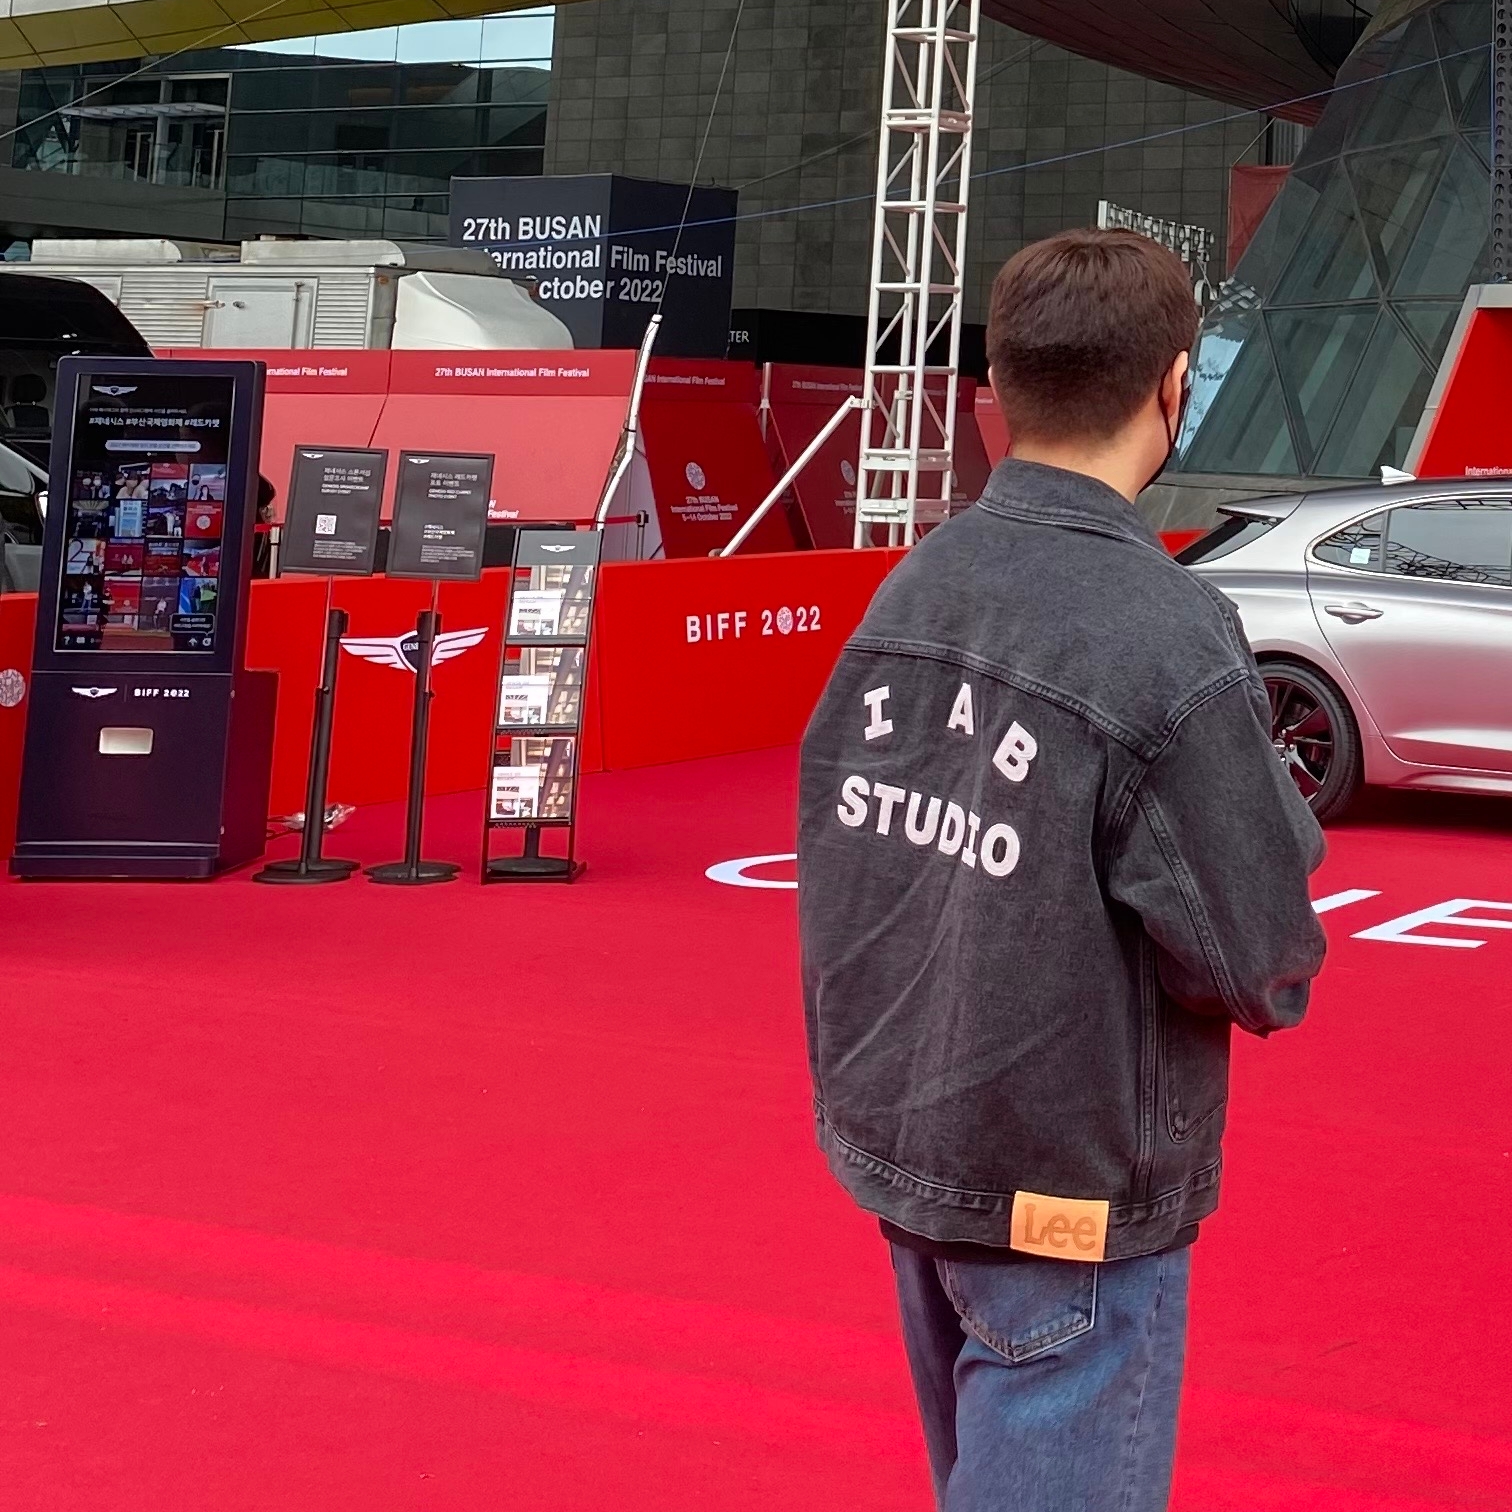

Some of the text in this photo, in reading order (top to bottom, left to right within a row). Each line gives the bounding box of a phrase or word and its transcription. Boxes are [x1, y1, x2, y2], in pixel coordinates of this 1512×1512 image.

[463, 215, 600, 240] 27th BUSAN
[463, 245, 722, 277] ernational Film Festival
[526, 275, 663, 303] ctober 2022
[728, 330, 750, 343] TER
[302, 367, 317, 376] Film
[319, 367, 347, 376] Festival
[435, 367, 590, 378] 27th BUSAN International Film Festival
[686, 611, 747, 643] BIFF
[134, 688, 190, 698] BIFF 2022
[837, 775, 1021, 877] STUDIO
[1024, 1203, 1097, 1251] Lee
